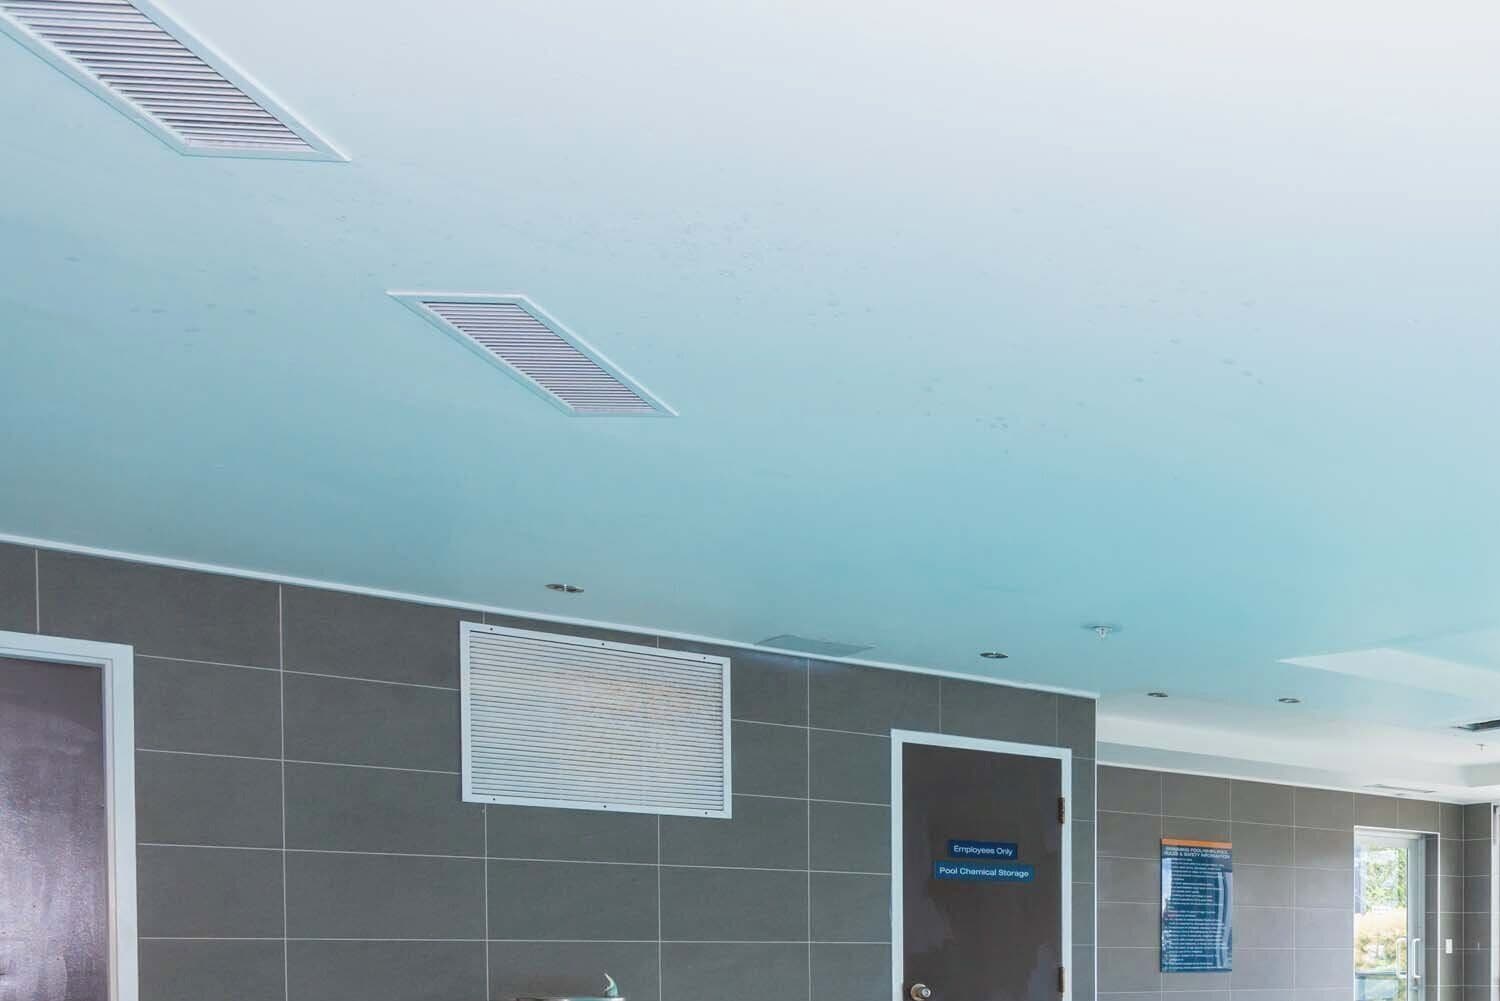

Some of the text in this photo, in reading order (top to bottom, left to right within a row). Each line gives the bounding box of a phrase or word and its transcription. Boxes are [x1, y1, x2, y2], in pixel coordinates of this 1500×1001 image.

[953, 845, 1013, 857] Employees Only
[939, 866, 1029, 879] Pool Chemical Storage
